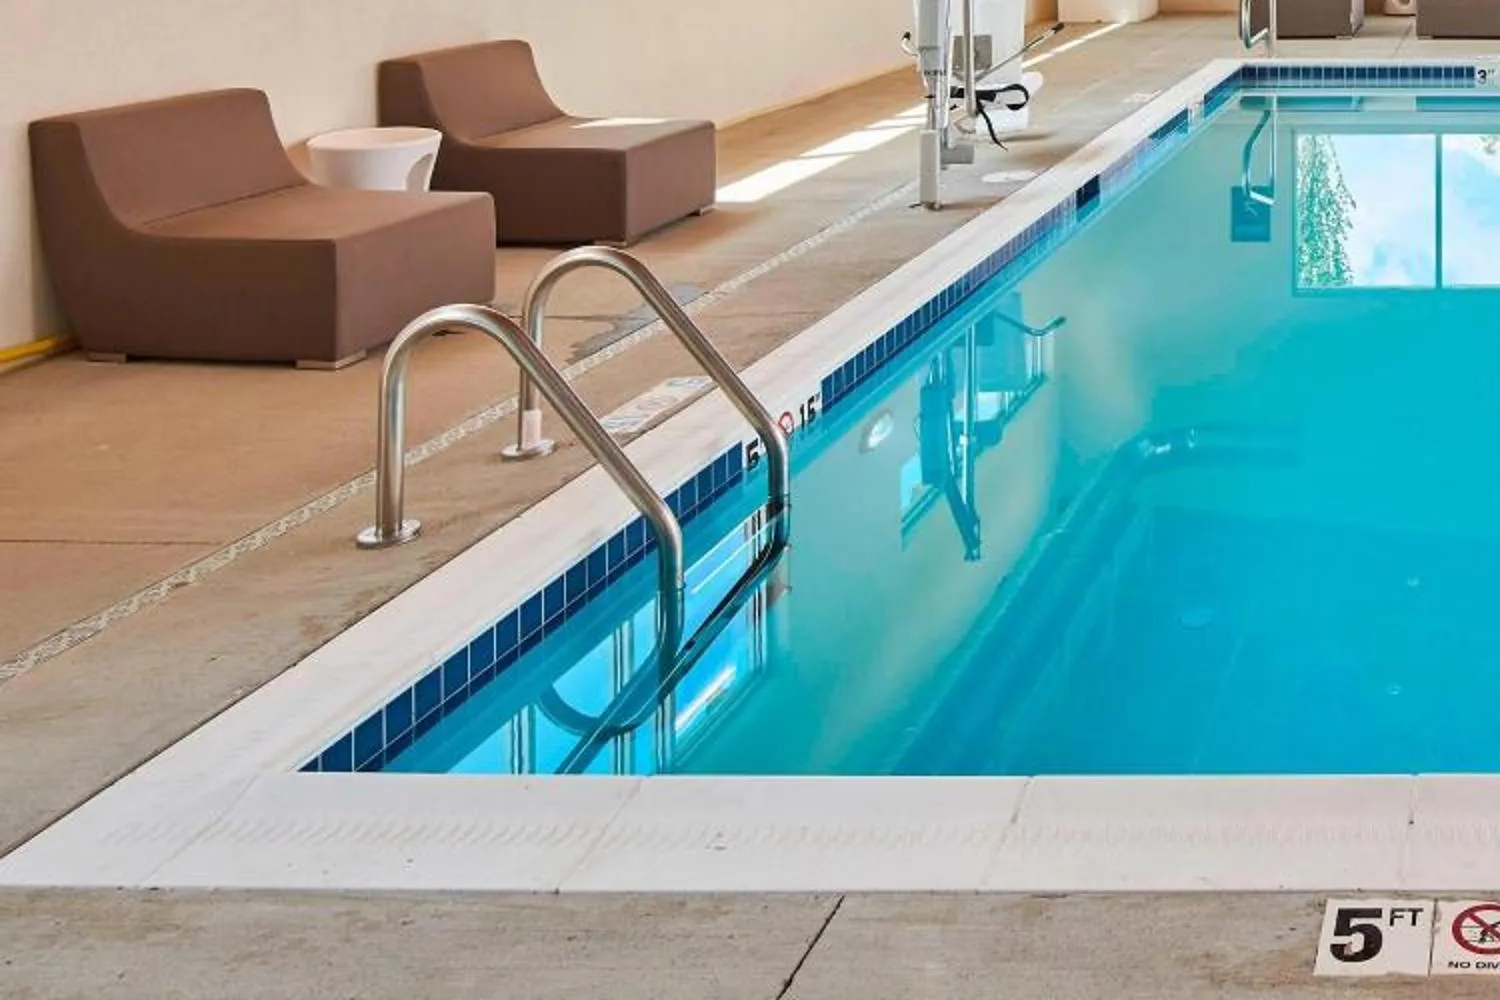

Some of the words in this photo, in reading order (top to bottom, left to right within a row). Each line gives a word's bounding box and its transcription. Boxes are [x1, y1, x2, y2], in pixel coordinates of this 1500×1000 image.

[1330, 908, 1383, 963] 5
[1389, 907, 1424, 927] FT
[1448, 961, 1471, 969] NO
